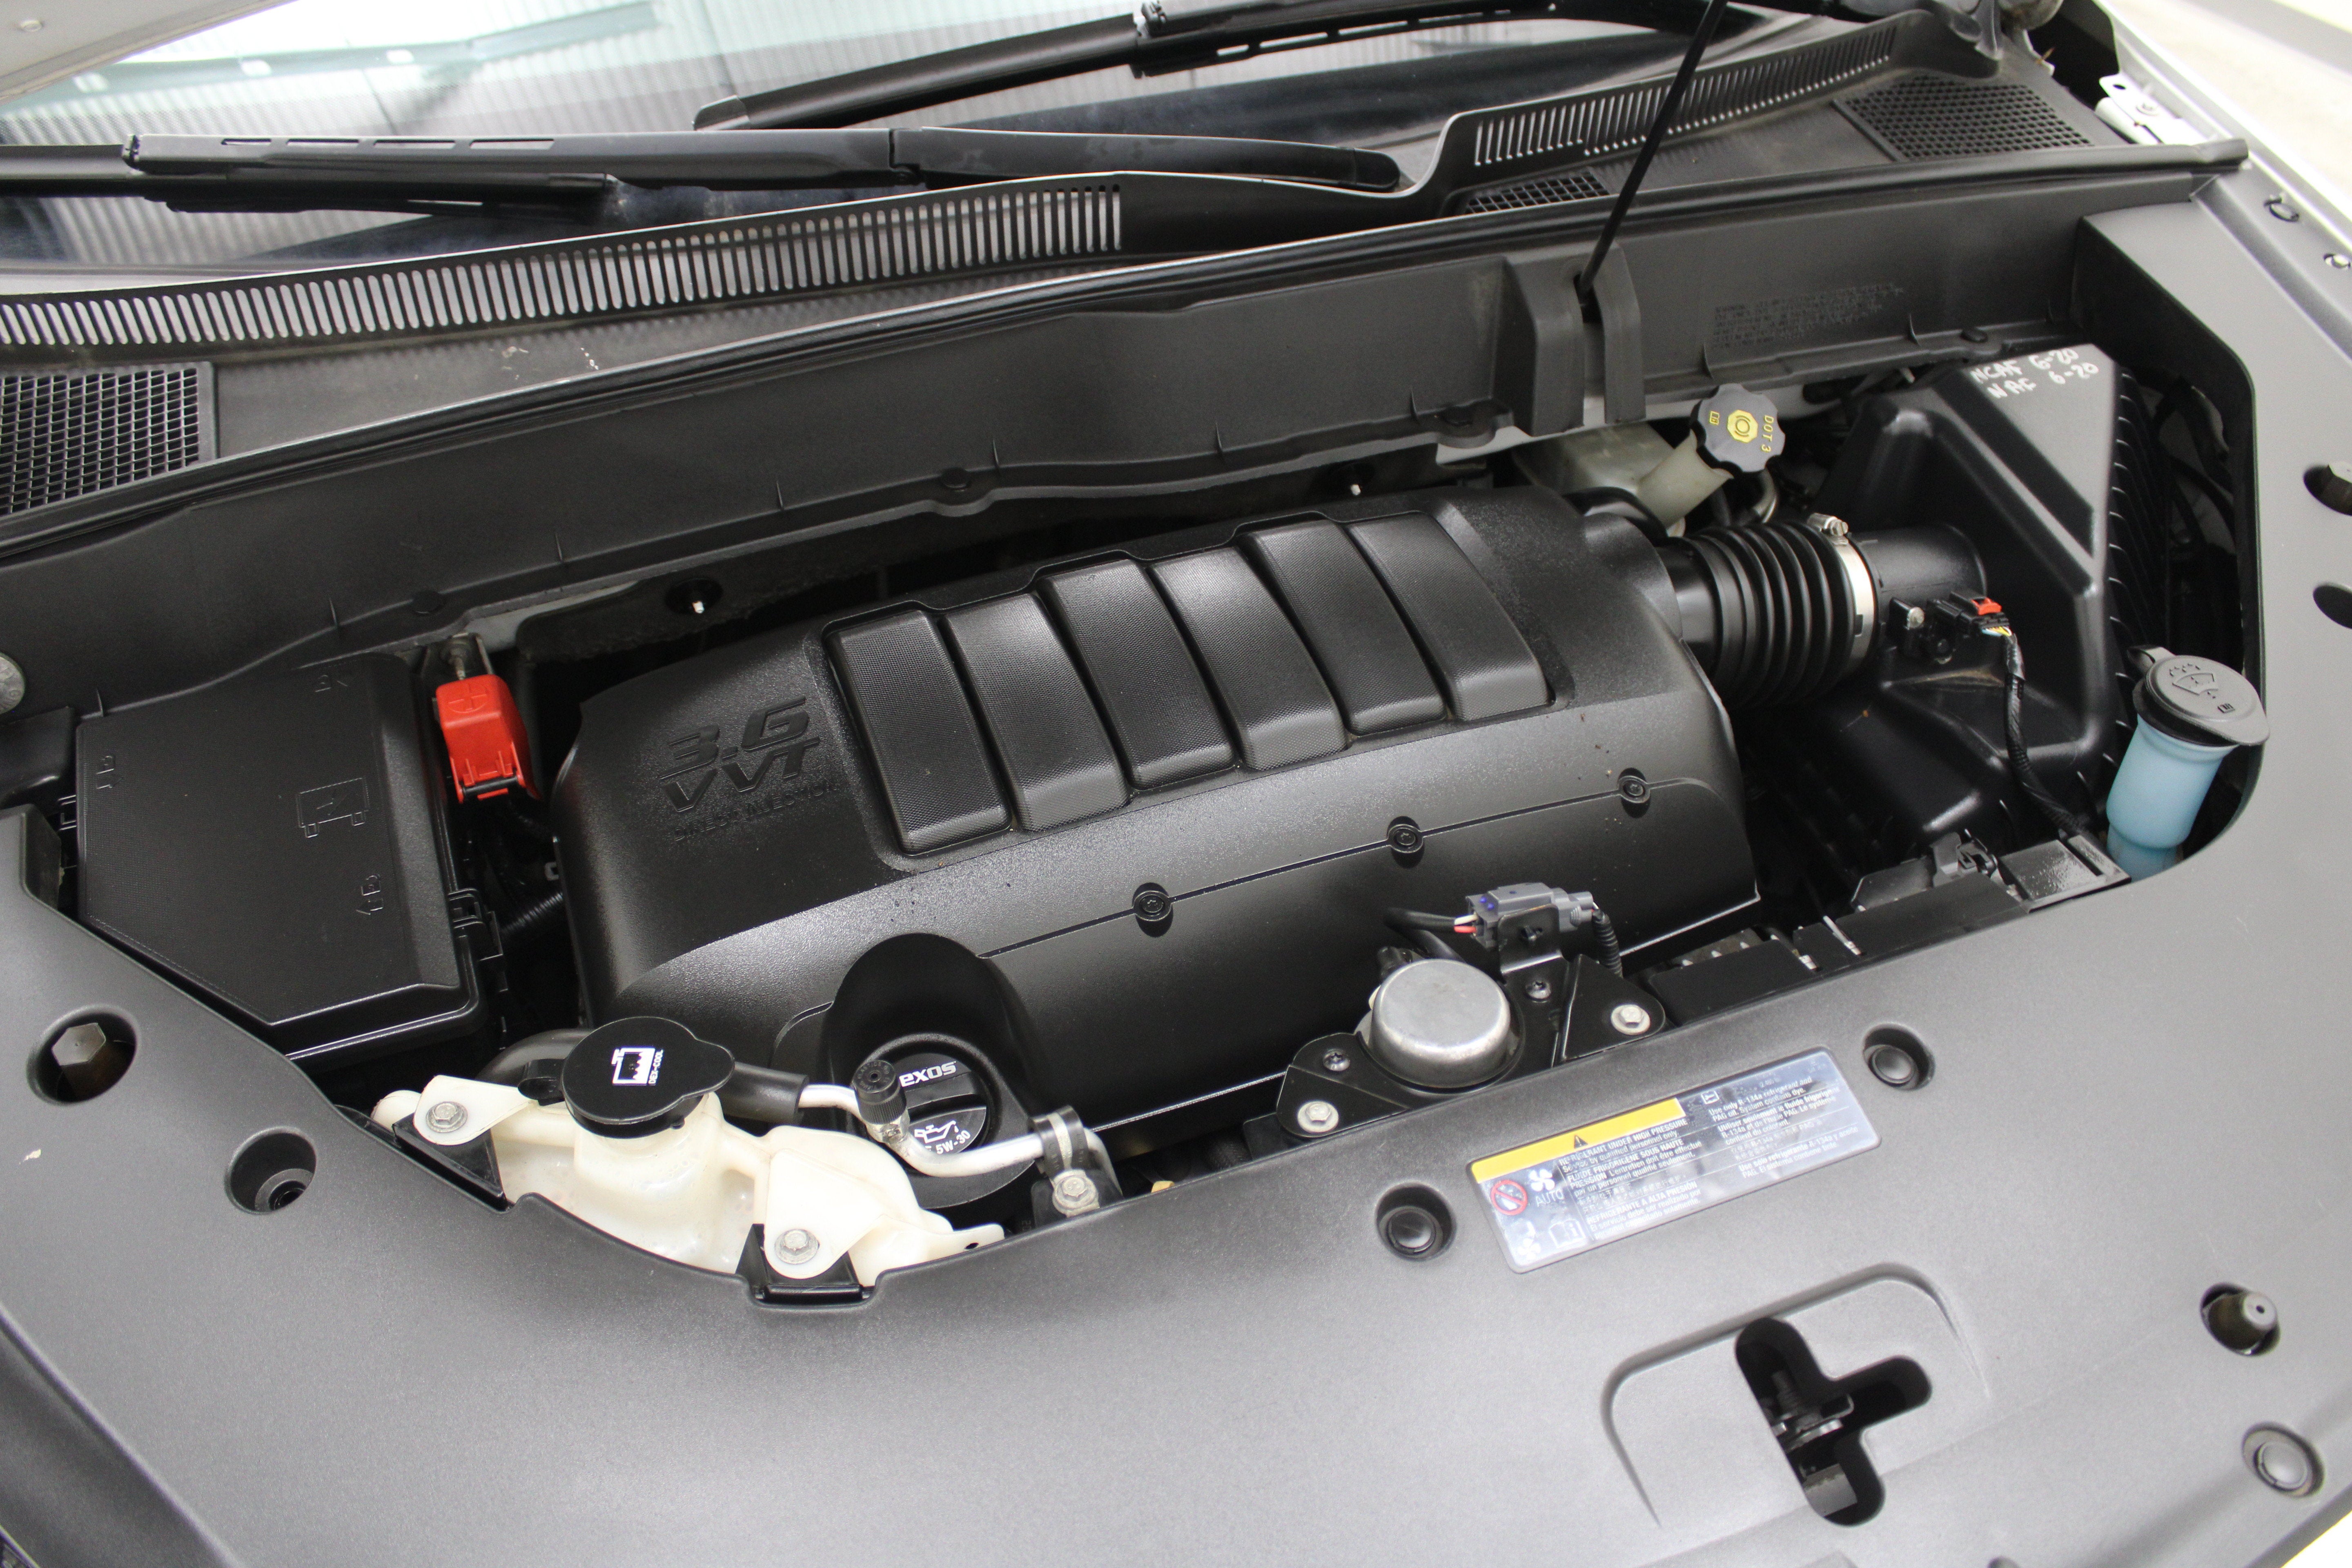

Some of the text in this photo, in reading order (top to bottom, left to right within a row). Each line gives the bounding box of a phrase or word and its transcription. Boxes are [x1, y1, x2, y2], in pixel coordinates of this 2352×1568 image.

[2048, 362, 2099, 384] 6-20
[1761, 415, 1774, 453] DOT 3
[662, 736, 820, 813] VVT
[648, 1049, 664, 1085] DEX-COOL
[1708, 1107, 1723, 1116] Use
[1722, 1101, 1739, 1112] only
[1737, 1093, 1763, 1105] R-134a
[1713, 1113, 1727, 1122] PAG
[1791, 1087, 1806, 1096] dye.
[935, 1130, 971, 1154] 5W-30
[1607, 1136, 1633, 1149] UNDER
[1632, 1130, 1651, 1141] HIGH
[1650, 1118, 1687, 1135] PRESSURE
[1721, 1125, 1746, 1138] R-134a
[1589, 1156, 1599, 1164] by
[1629, 1134, 1663, 1151] personnel
[1640, 1146, 1660, 1158] SOUS
[1659, 1138, 1684, 1151] HAUTE
[1644, 1154, 1659, 1164] doit
[1738, 1162, 1753, 1172] Use
[1597, 1172, 1632, 1189] personnel
[1533, 1188, 1566, 1207] AUTO
[1586, 1200, 1641, 1225] REFRIGERANTE
[1648, 1192, 1666, 1203] ALTA
[1665, 1180, 1697, 1197] PRESIÓN
